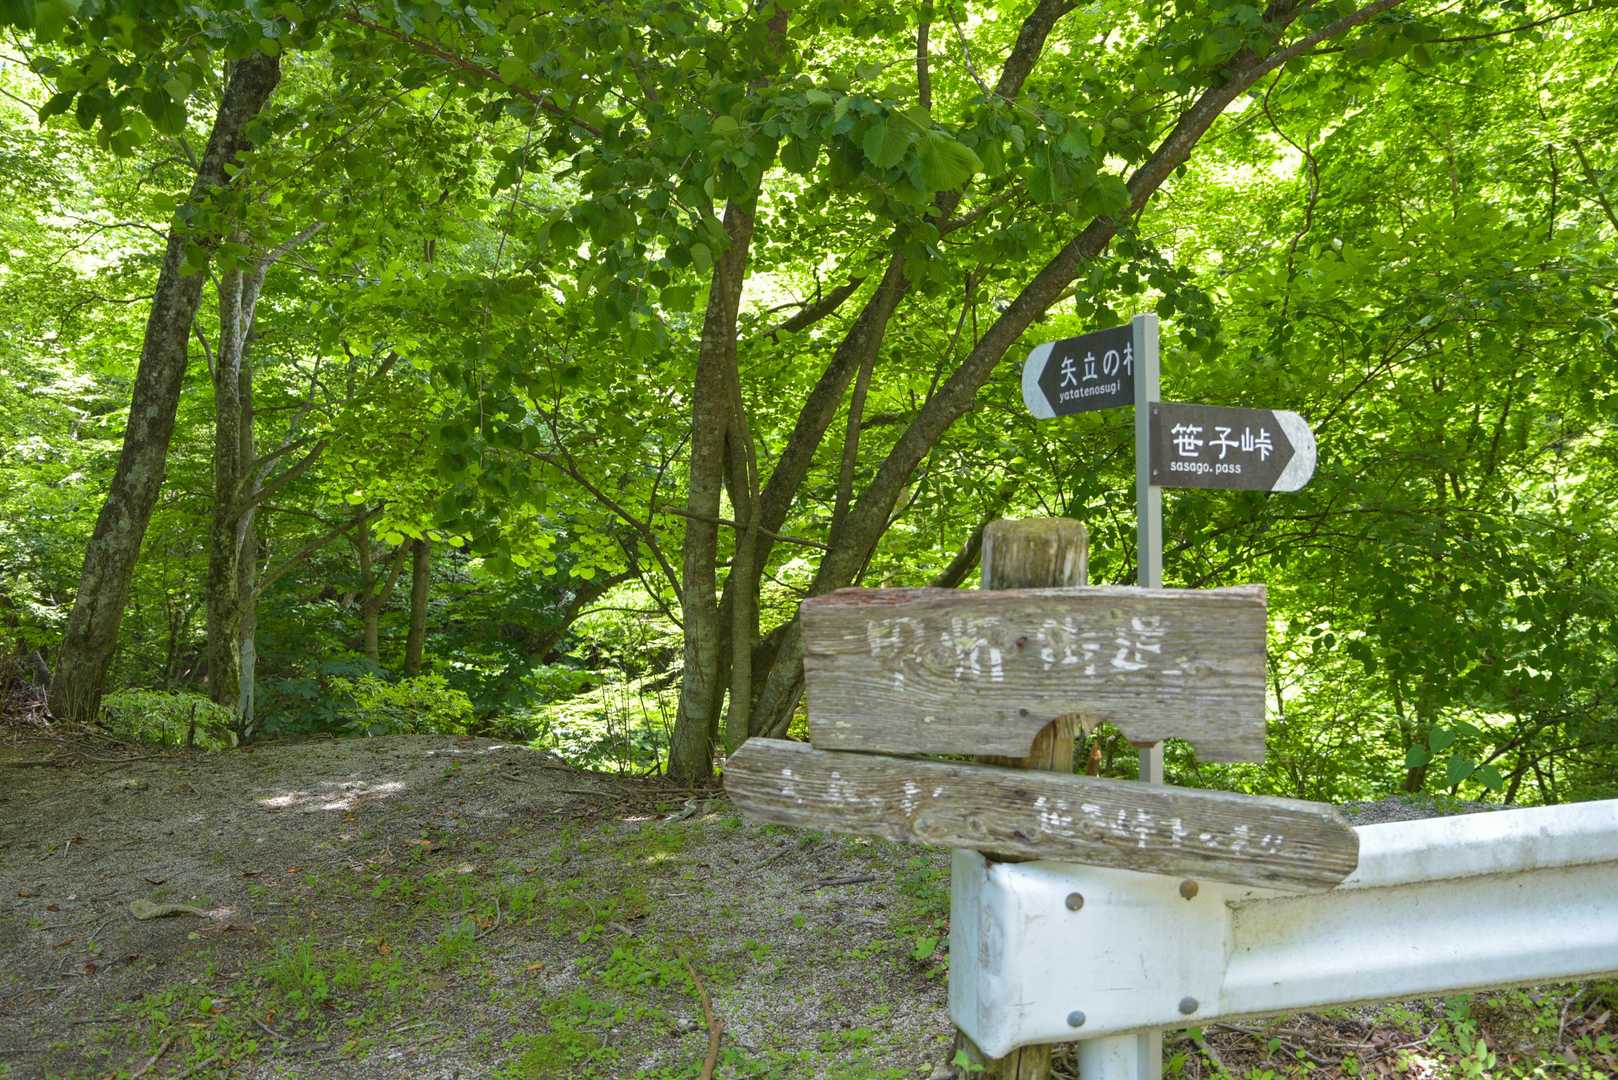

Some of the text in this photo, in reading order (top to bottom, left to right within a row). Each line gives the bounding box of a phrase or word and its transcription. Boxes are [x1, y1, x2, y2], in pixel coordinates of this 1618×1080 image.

[1059, 379, 1121, 403] yatatenosugi
[1170, 423, 1273, 462] 笹子峠
